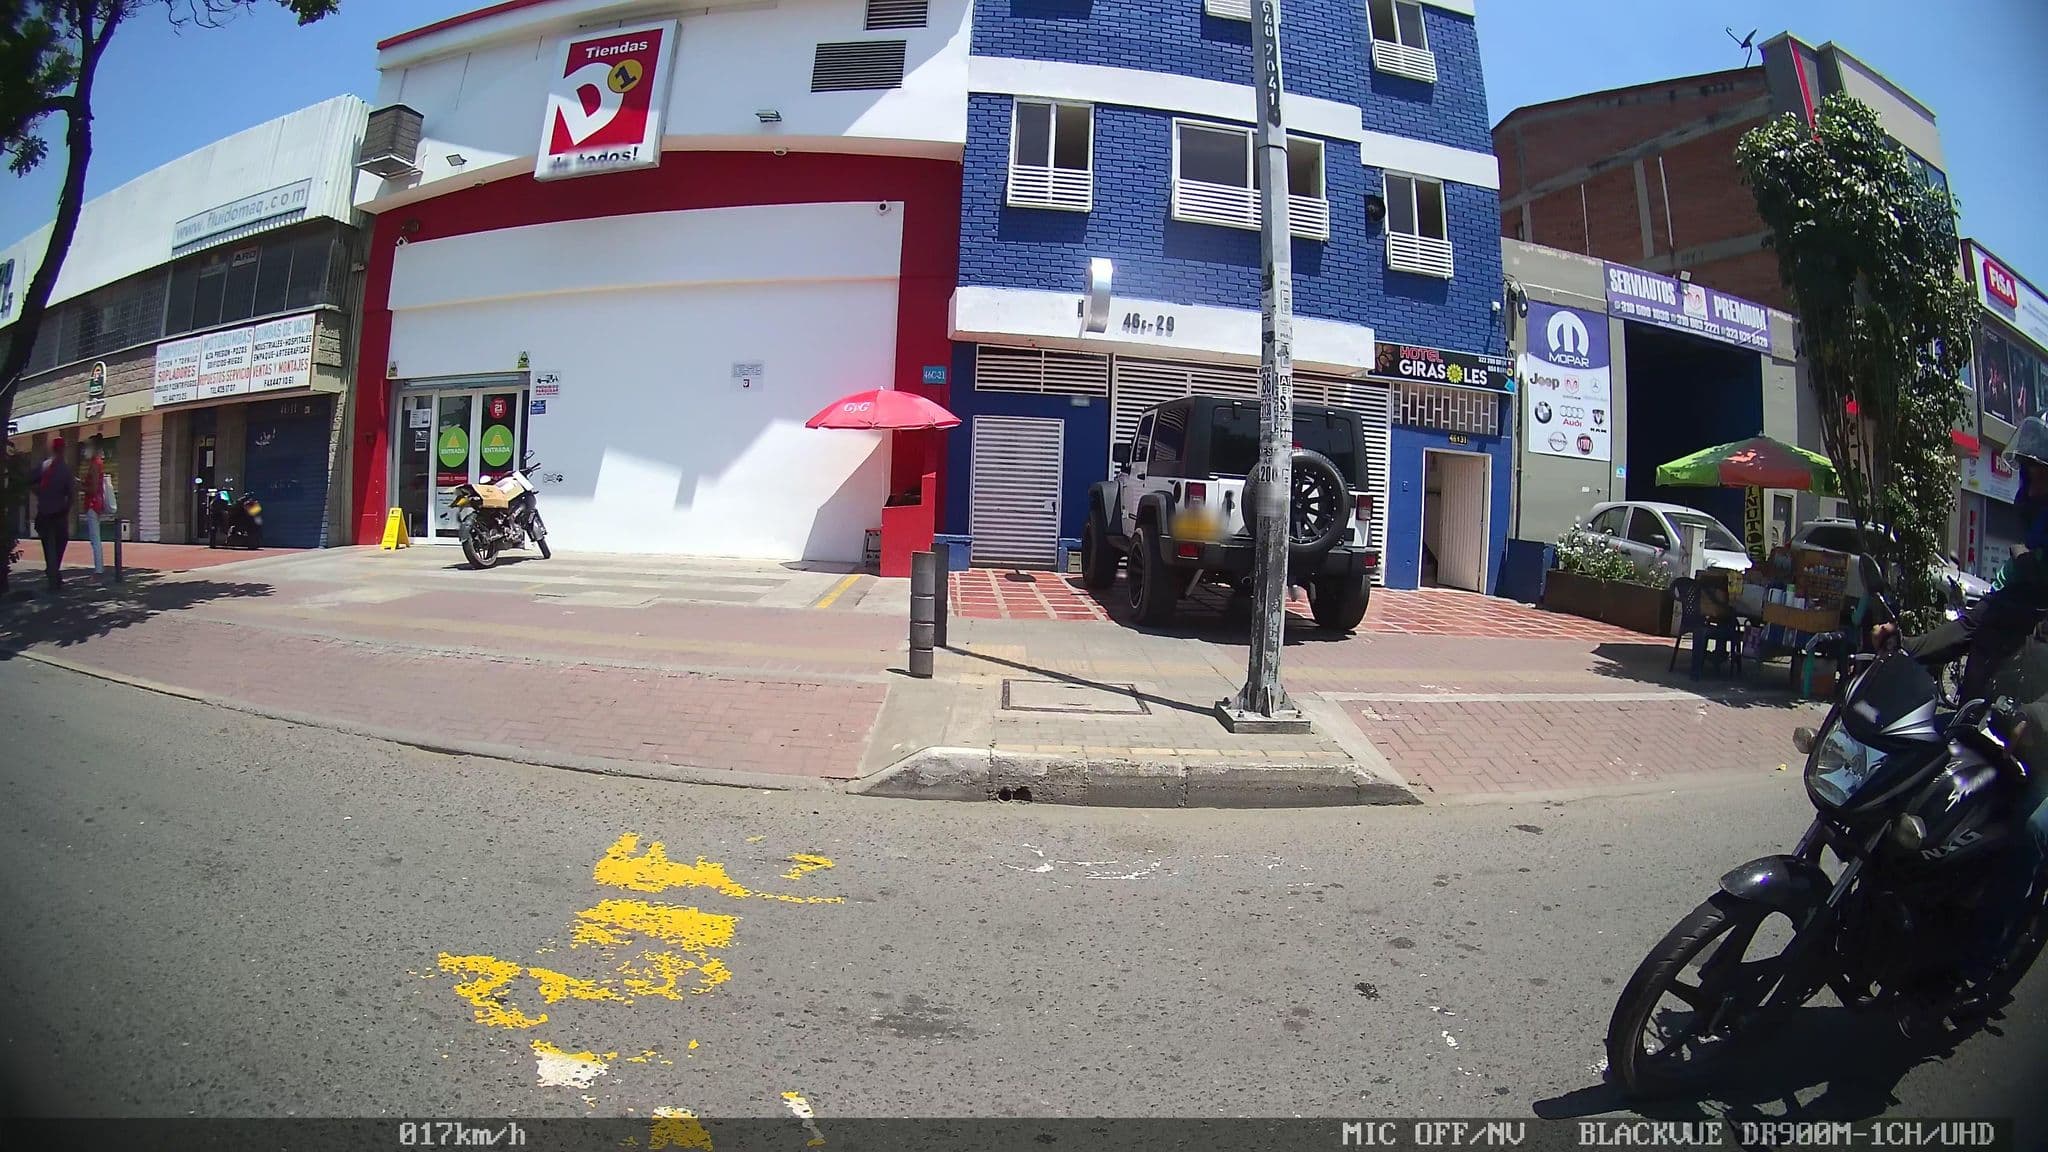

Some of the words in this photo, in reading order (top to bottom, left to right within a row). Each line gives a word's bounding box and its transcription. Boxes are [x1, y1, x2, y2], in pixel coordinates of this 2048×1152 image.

[586, 41, 648, 59] Tiendas
[1609, 268, 1676, 306] SERVIAUTOS
[1988, 265, 2015, 301] FISA
[1713, 295, 1767, 331] PREMIUM
[1399, 346, 1444, 364] HOTEL
[1548, 351, 1590, 368] MOPAR
[158, 365, 196, 382] SOPLADORES
[253, 363, 272, 377] VENTAS
[279, 358, 309, 374] MONTAJES
[1530, 373, 1560, 391] Jeep
[1562, 418, 1583, 428] Audi
[484, 446, 511, 454] ENTRADA
